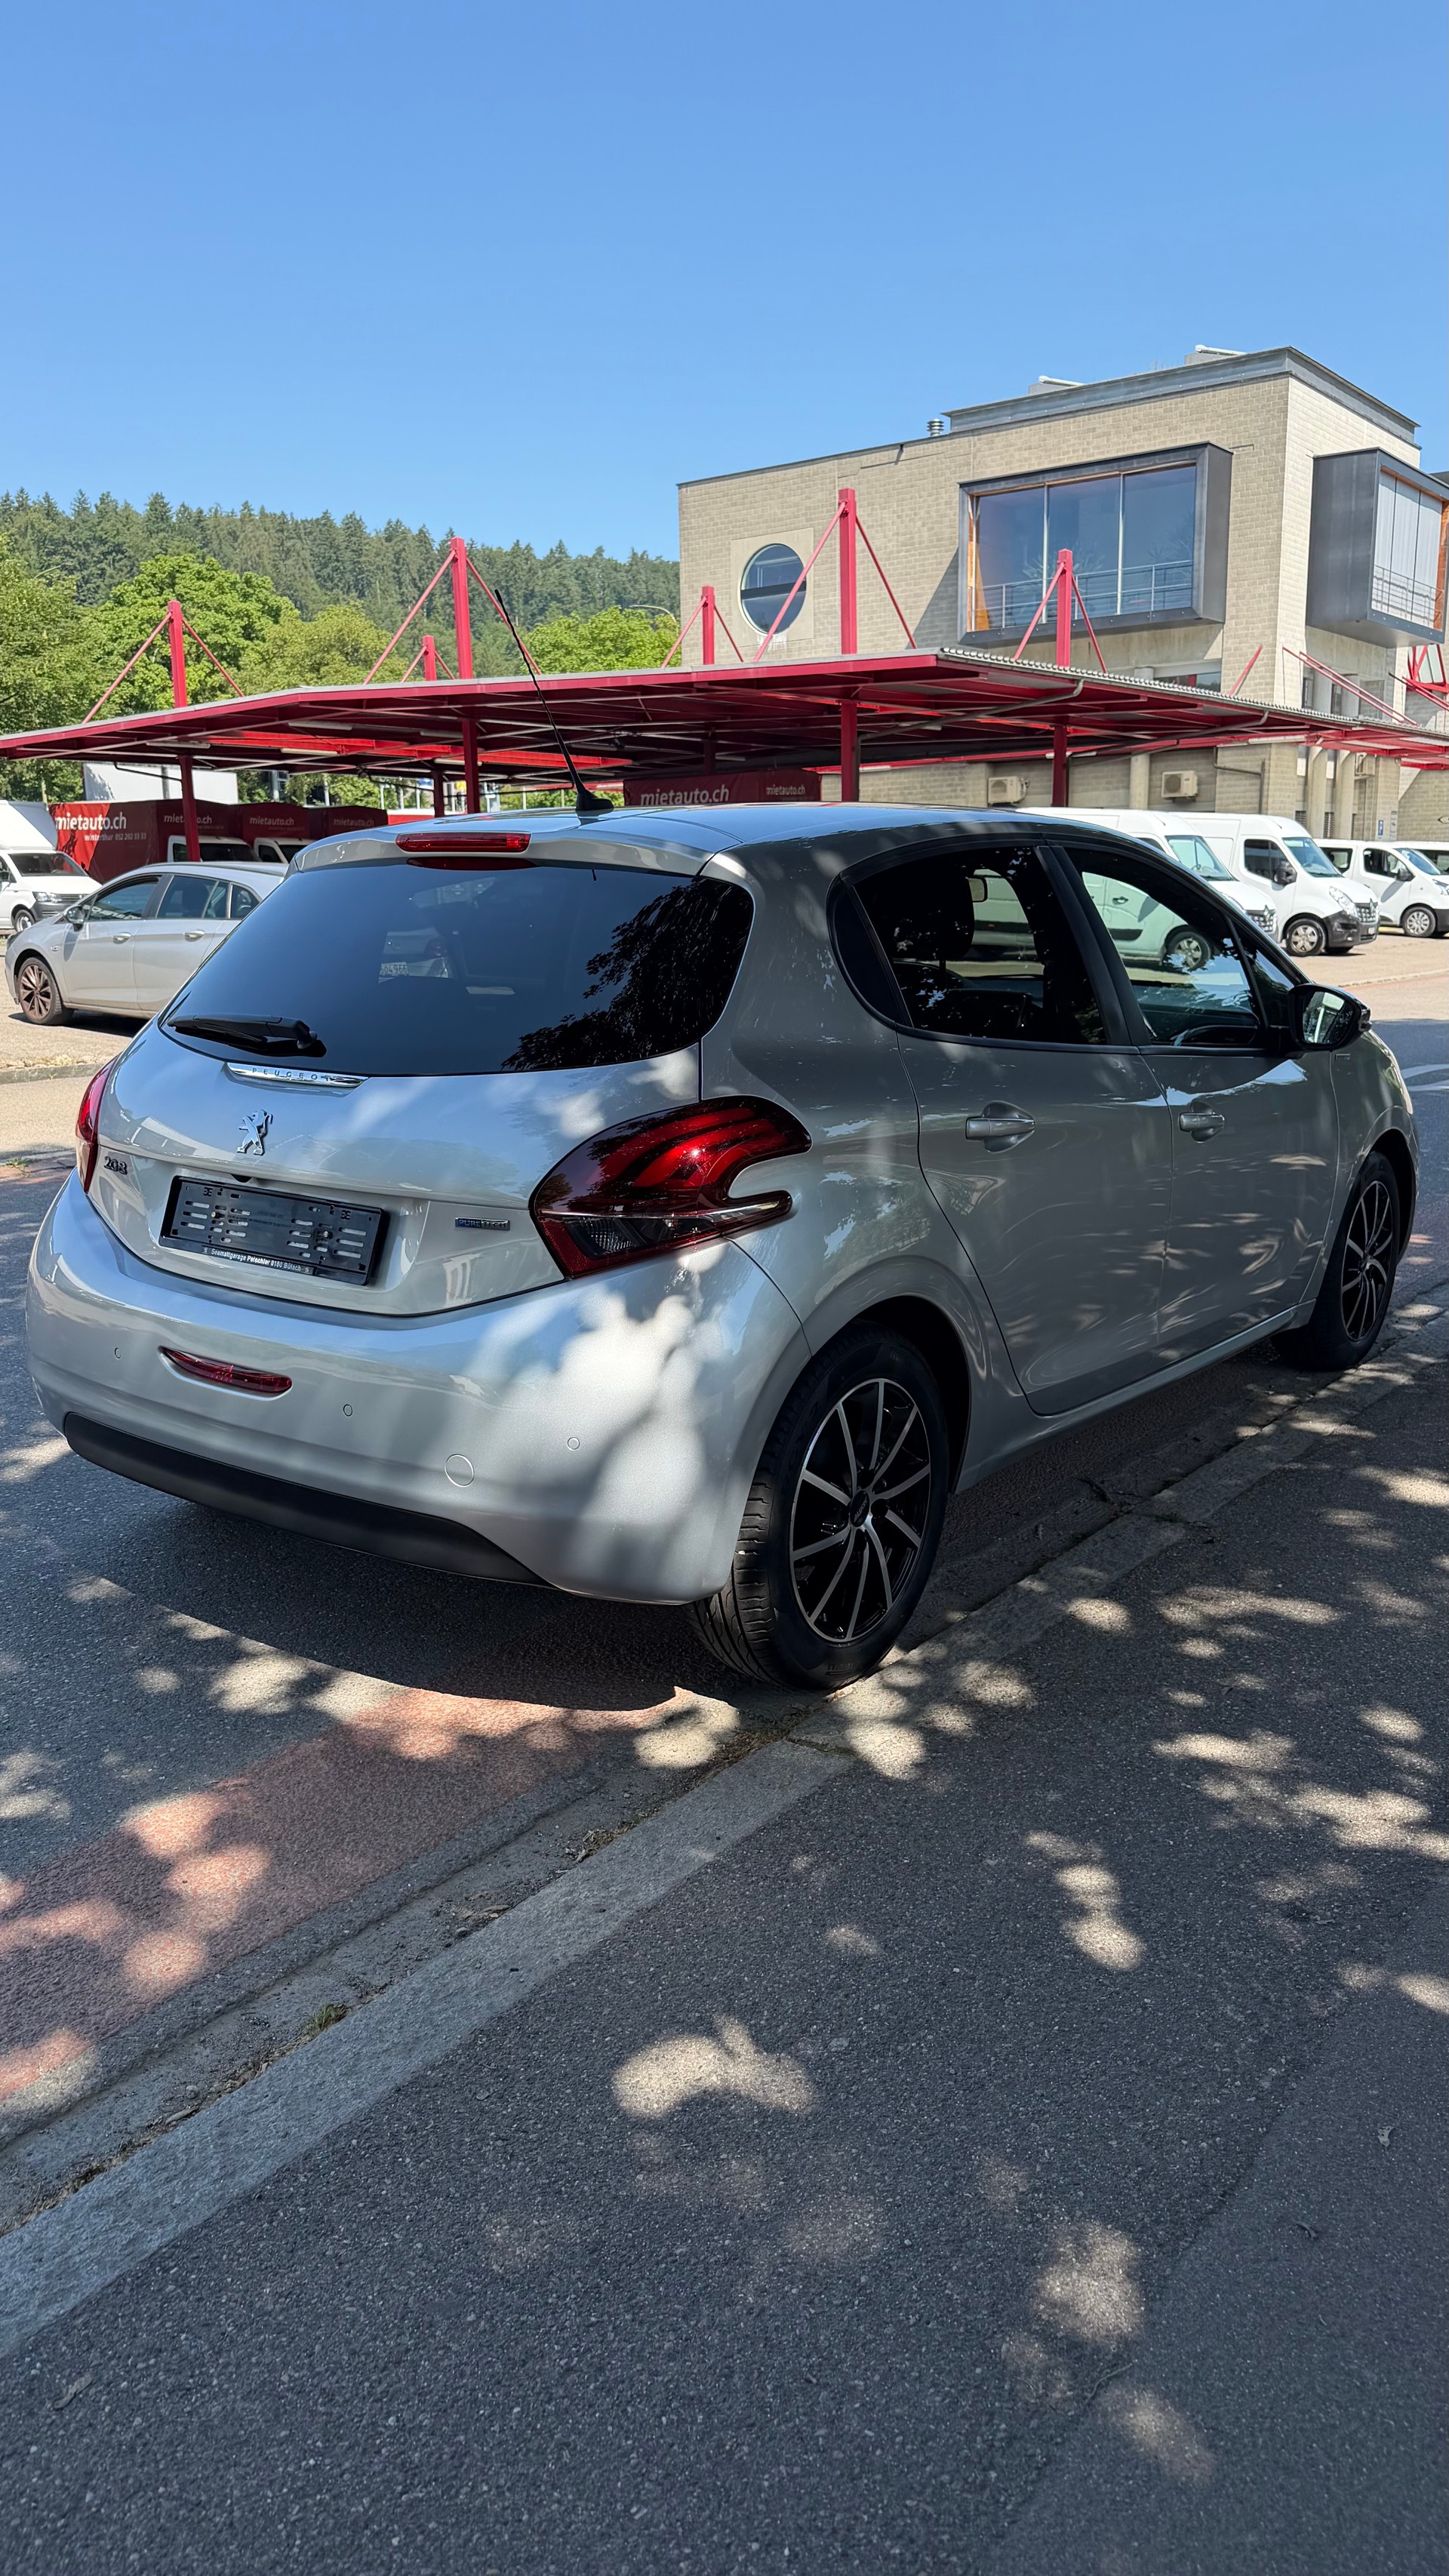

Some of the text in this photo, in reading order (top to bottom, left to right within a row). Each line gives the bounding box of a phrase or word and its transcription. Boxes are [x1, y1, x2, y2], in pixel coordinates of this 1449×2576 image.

[641, 784, 729, 806] mietauto.ch
[766, 785, 805, 796] mietauto.ch
[55, 812, 127, 830] mietauto.ch
[164, 814, 212, 824] mieto.ch
[250, 816, 294, 826] mietauto.ch
[334, 817, 374, 826] mietauto.ch
[252, 1067, 329, 1081] PEUGEOT
[104, 1156, 128, 1174] 208
